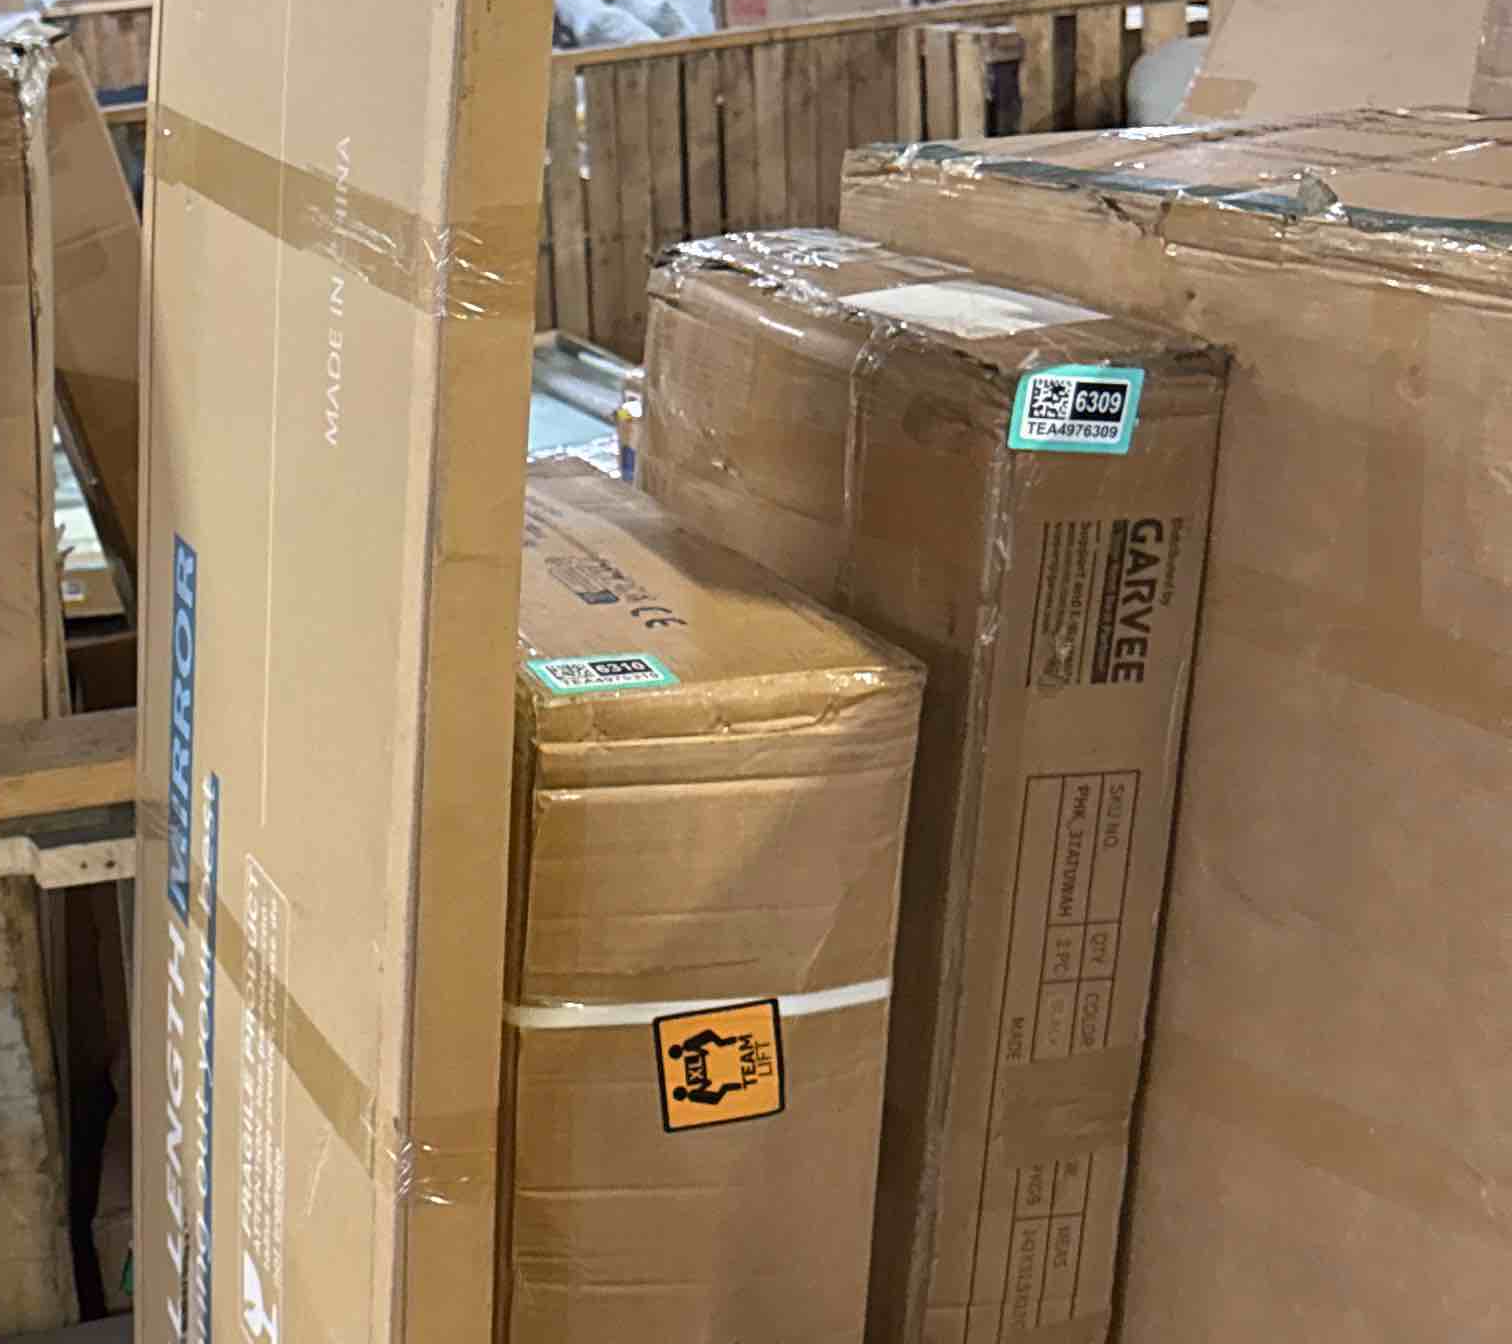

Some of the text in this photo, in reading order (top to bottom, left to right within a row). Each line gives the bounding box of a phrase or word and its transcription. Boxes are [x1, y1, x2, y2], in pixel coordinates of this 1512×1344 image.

[328, 277, 346, 318] IN
[324, 329, 344, 447] MADE
[1075, 391, 1123, 415] 6309
[1027, 421, 1119, 439] TEA4976309
[1111, 517, 1165, 684] GARVEE
[595, 661, 645, 674] 6310
[169, 544, 196, 913] MIRROR
[244, 856, 257, 1066] PRODUCT
[736, 1031, 758, 1091] TEAM
[754, 1037, 773, 1078] LIFT
[168, 919, 186, 1276] LENGTH
